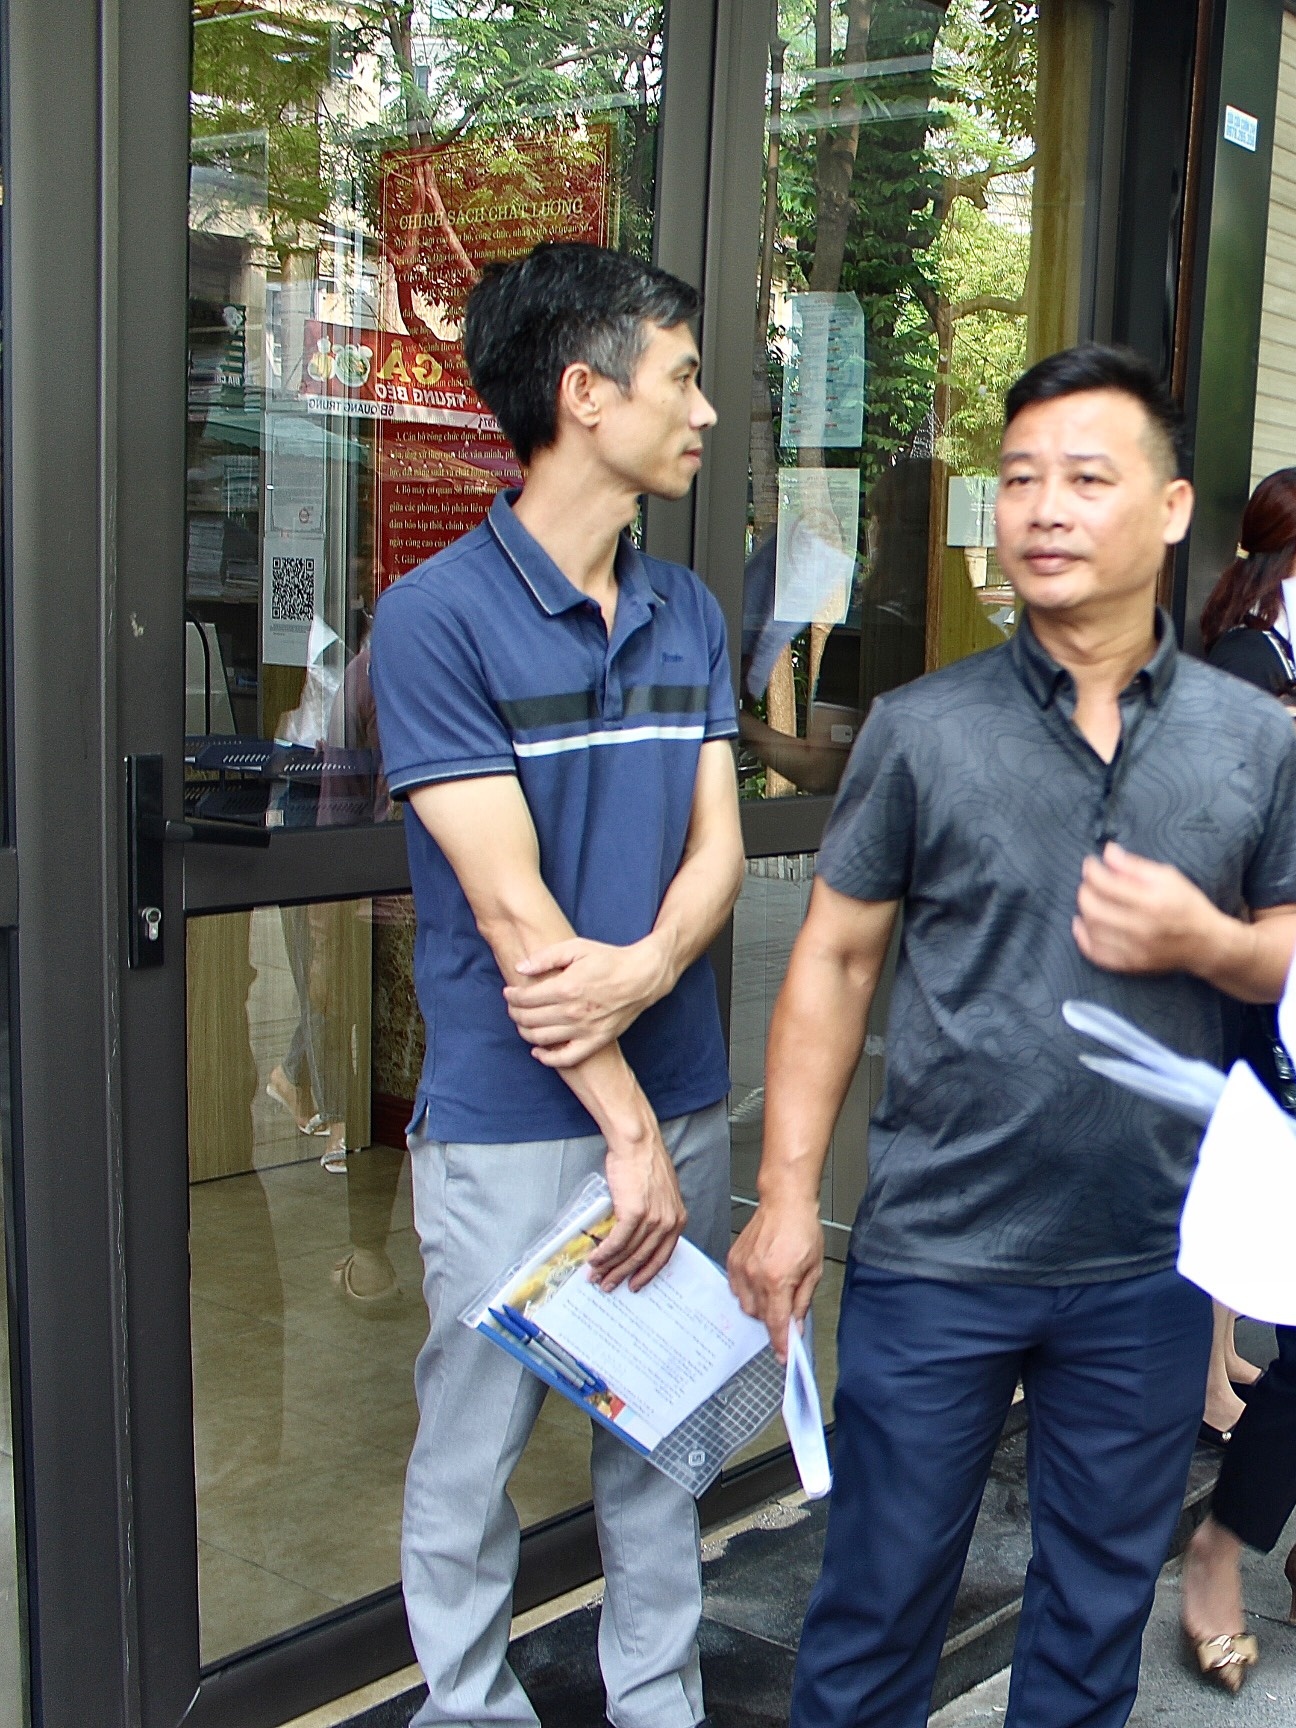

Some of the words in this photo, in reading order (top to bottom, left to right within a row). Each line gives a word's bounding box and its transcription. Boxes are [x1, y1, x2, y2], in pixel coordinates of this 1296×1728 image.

[447, 204, 485, 226] SÁCH
[390, 502, 404, 512] giữa
[405, 502, 416, 512] các
[417, 503, 440, 514] phòng,
[441, 503, 450, 514] bộ
[451, 503, 469, 514] phận
[470, 503, 483, 513] liên
[417, 520, 428, 531] kịp
[445, 521, 464, 530] chính
[421, 539, 434, 548] cao
